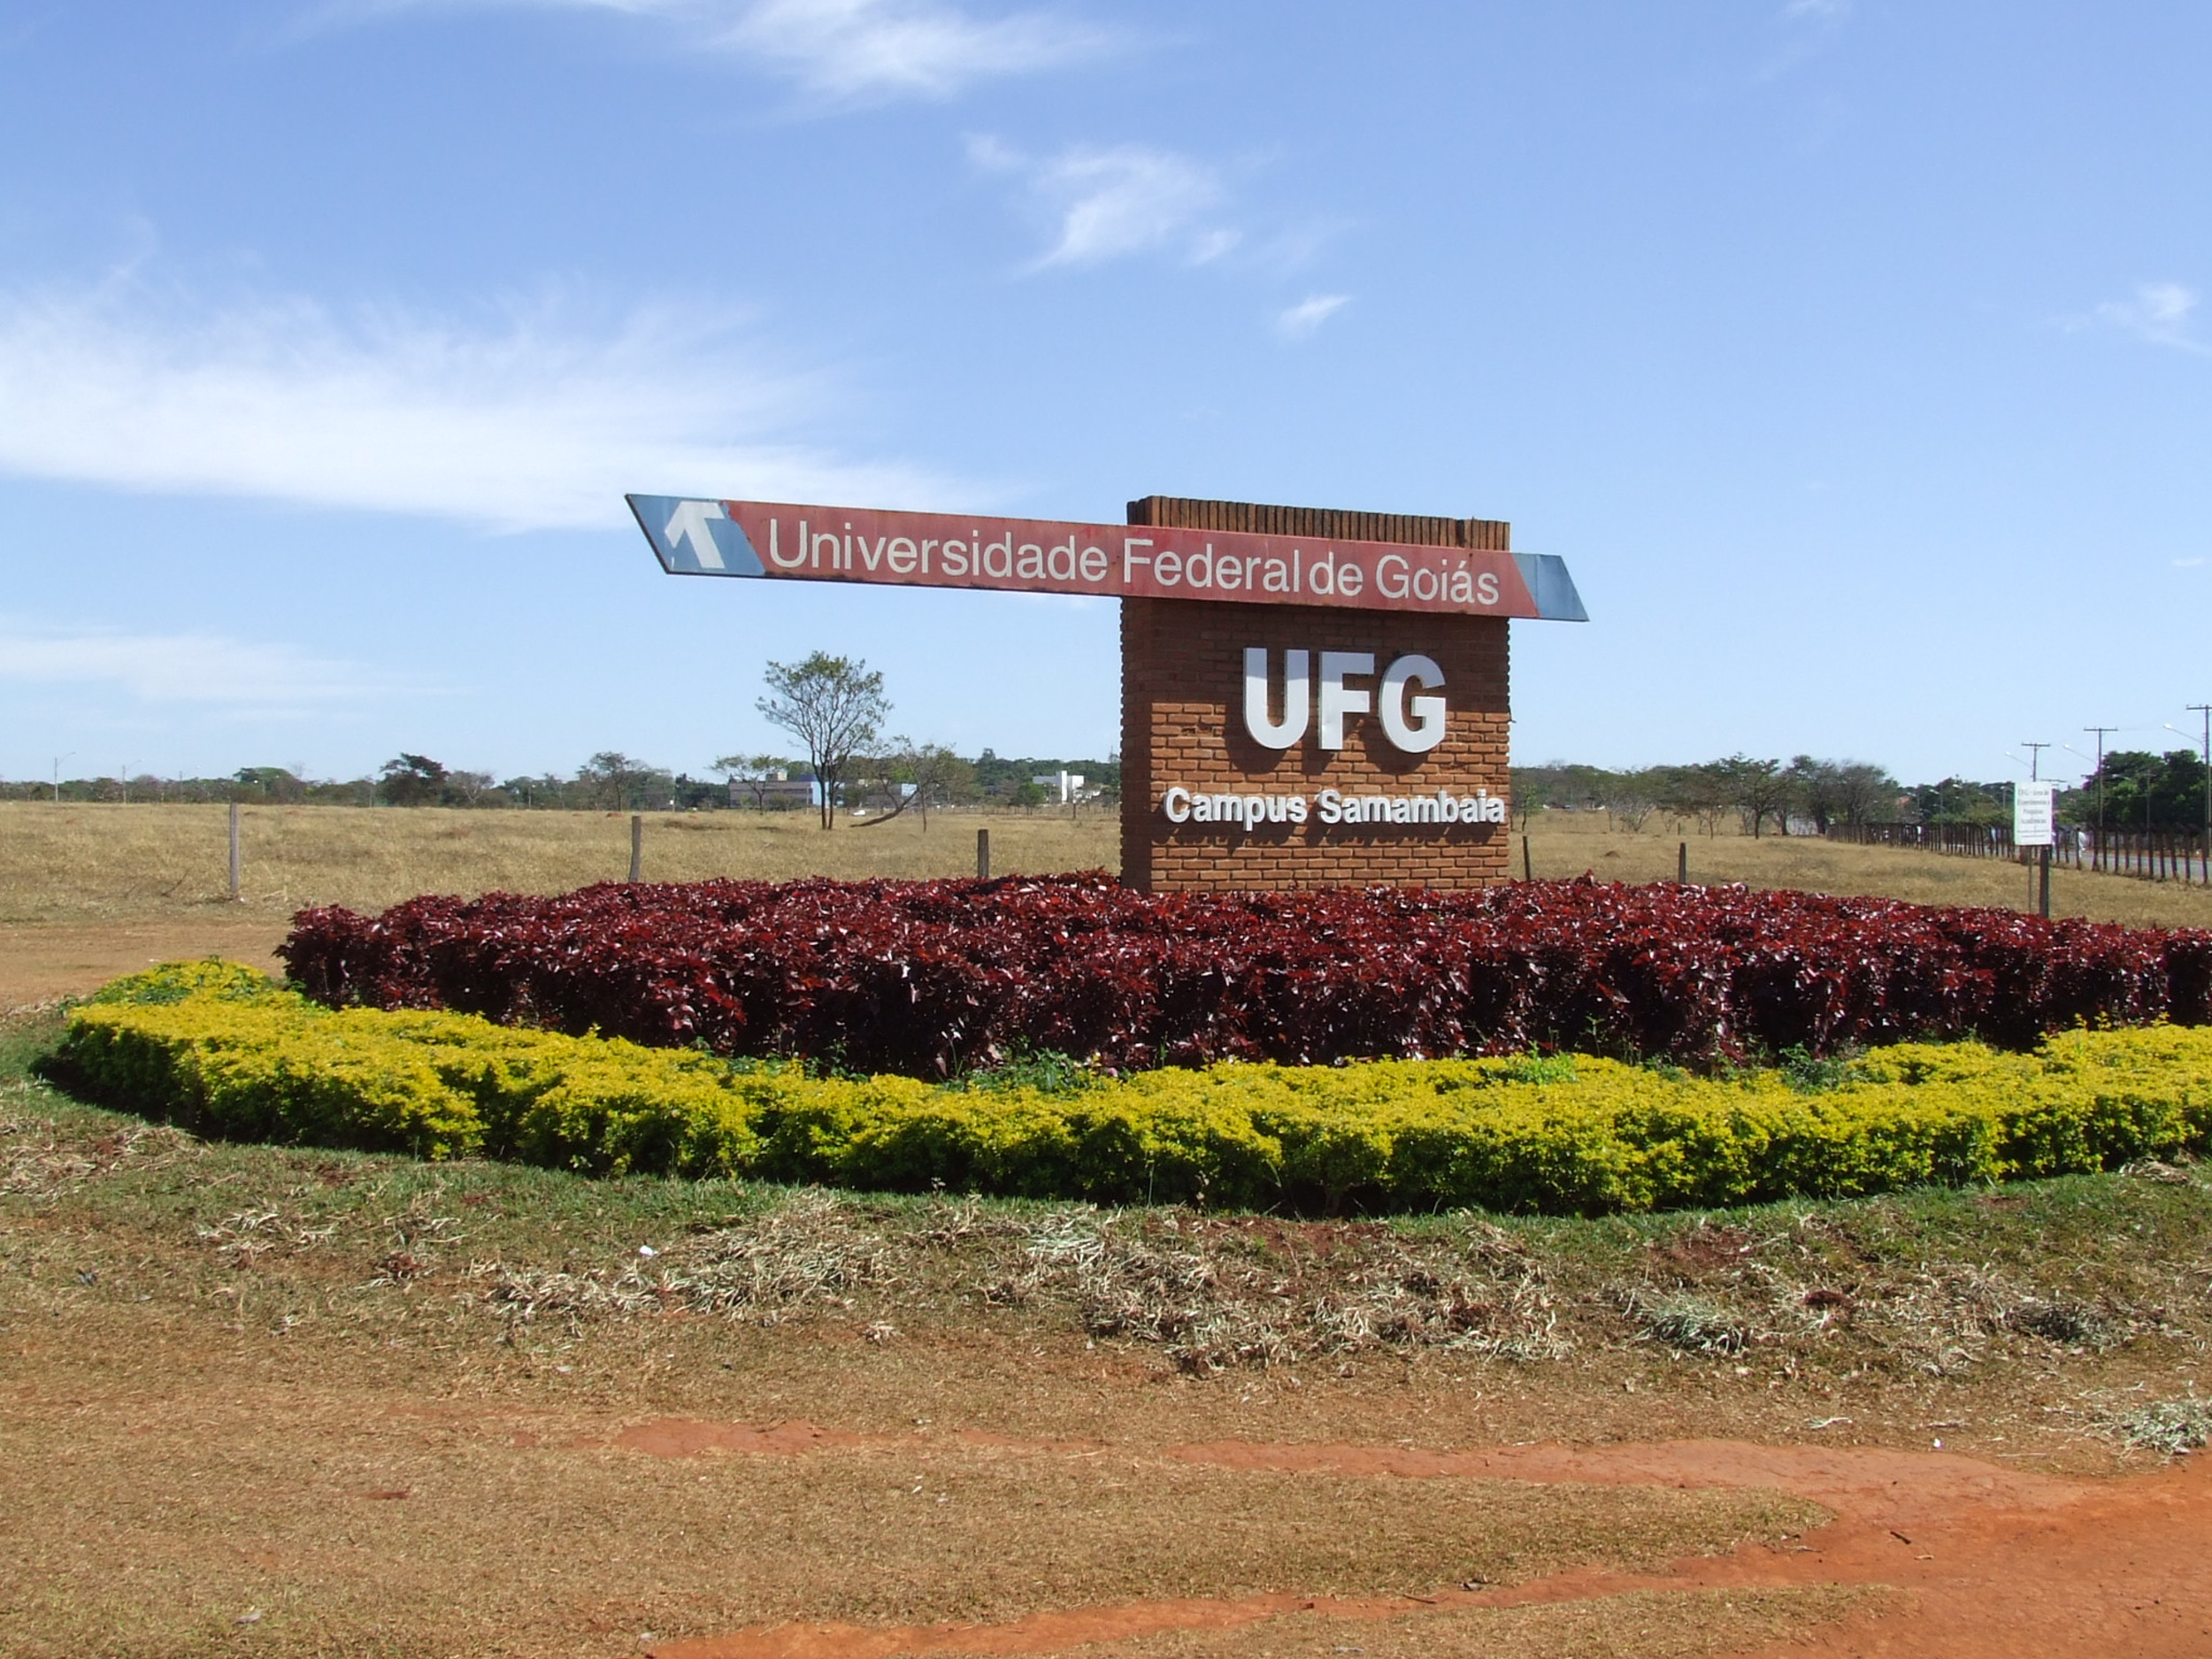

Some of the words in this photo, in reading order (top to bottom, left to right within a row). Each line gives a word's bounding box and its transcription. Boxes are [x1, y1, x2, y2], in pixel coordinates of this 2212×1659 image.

[769, 518, 1107, 581] Universidade
[1123, 538, 1300, 593] Federal
[1309, 550, 1363, 596] de
[1375, 554, 1500, 606] Goiás
[1243, 647, 1447, 753] UFG
[1163, 787, 1308, 832] Campus
[1317, 788, 1506, 824] Samambaia
